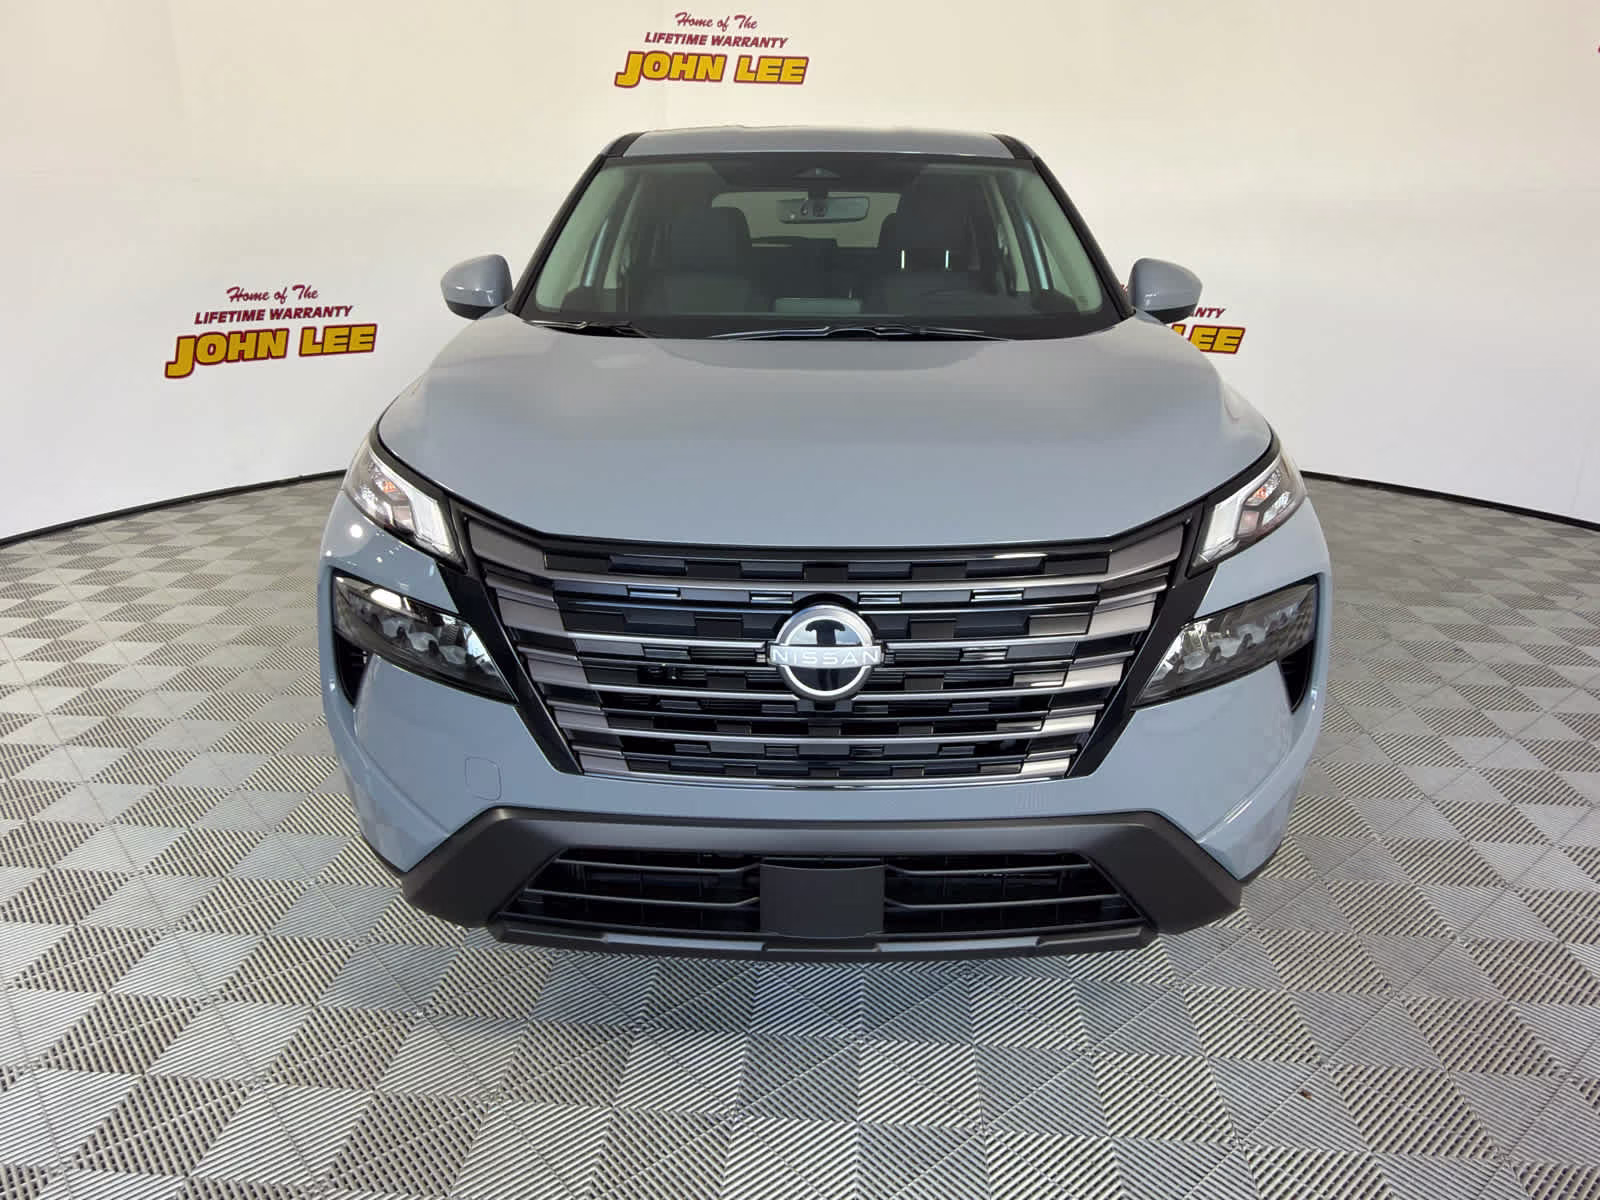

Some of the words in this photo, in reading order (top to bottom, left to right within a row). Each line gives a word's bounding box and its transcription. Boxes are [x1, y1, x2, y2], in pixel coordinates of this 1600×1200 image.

[675, 12, 713, 28] Home
[717, 15, 730, 31] of
[734, 15, 758, 29] The
[644, 32, 708, 46] LIFETIME
[711, 35, 788, 48] WARRANTY
[614, 51, 727, 88] JOHN
[733, 55, 809, 84] LEE
[226, 286, 269, 302] Home
[274, 287, 287, 304] of
[292, 284, 318, 300] The
[194, 309, 266, 325] LIFETIME
[269, 305, 353, 321] WARRANTY
[165, 328, 289, 378] JOHN
[298, 323, 377, 356] LEE
[772, 650, 878, 665] NISSAN
